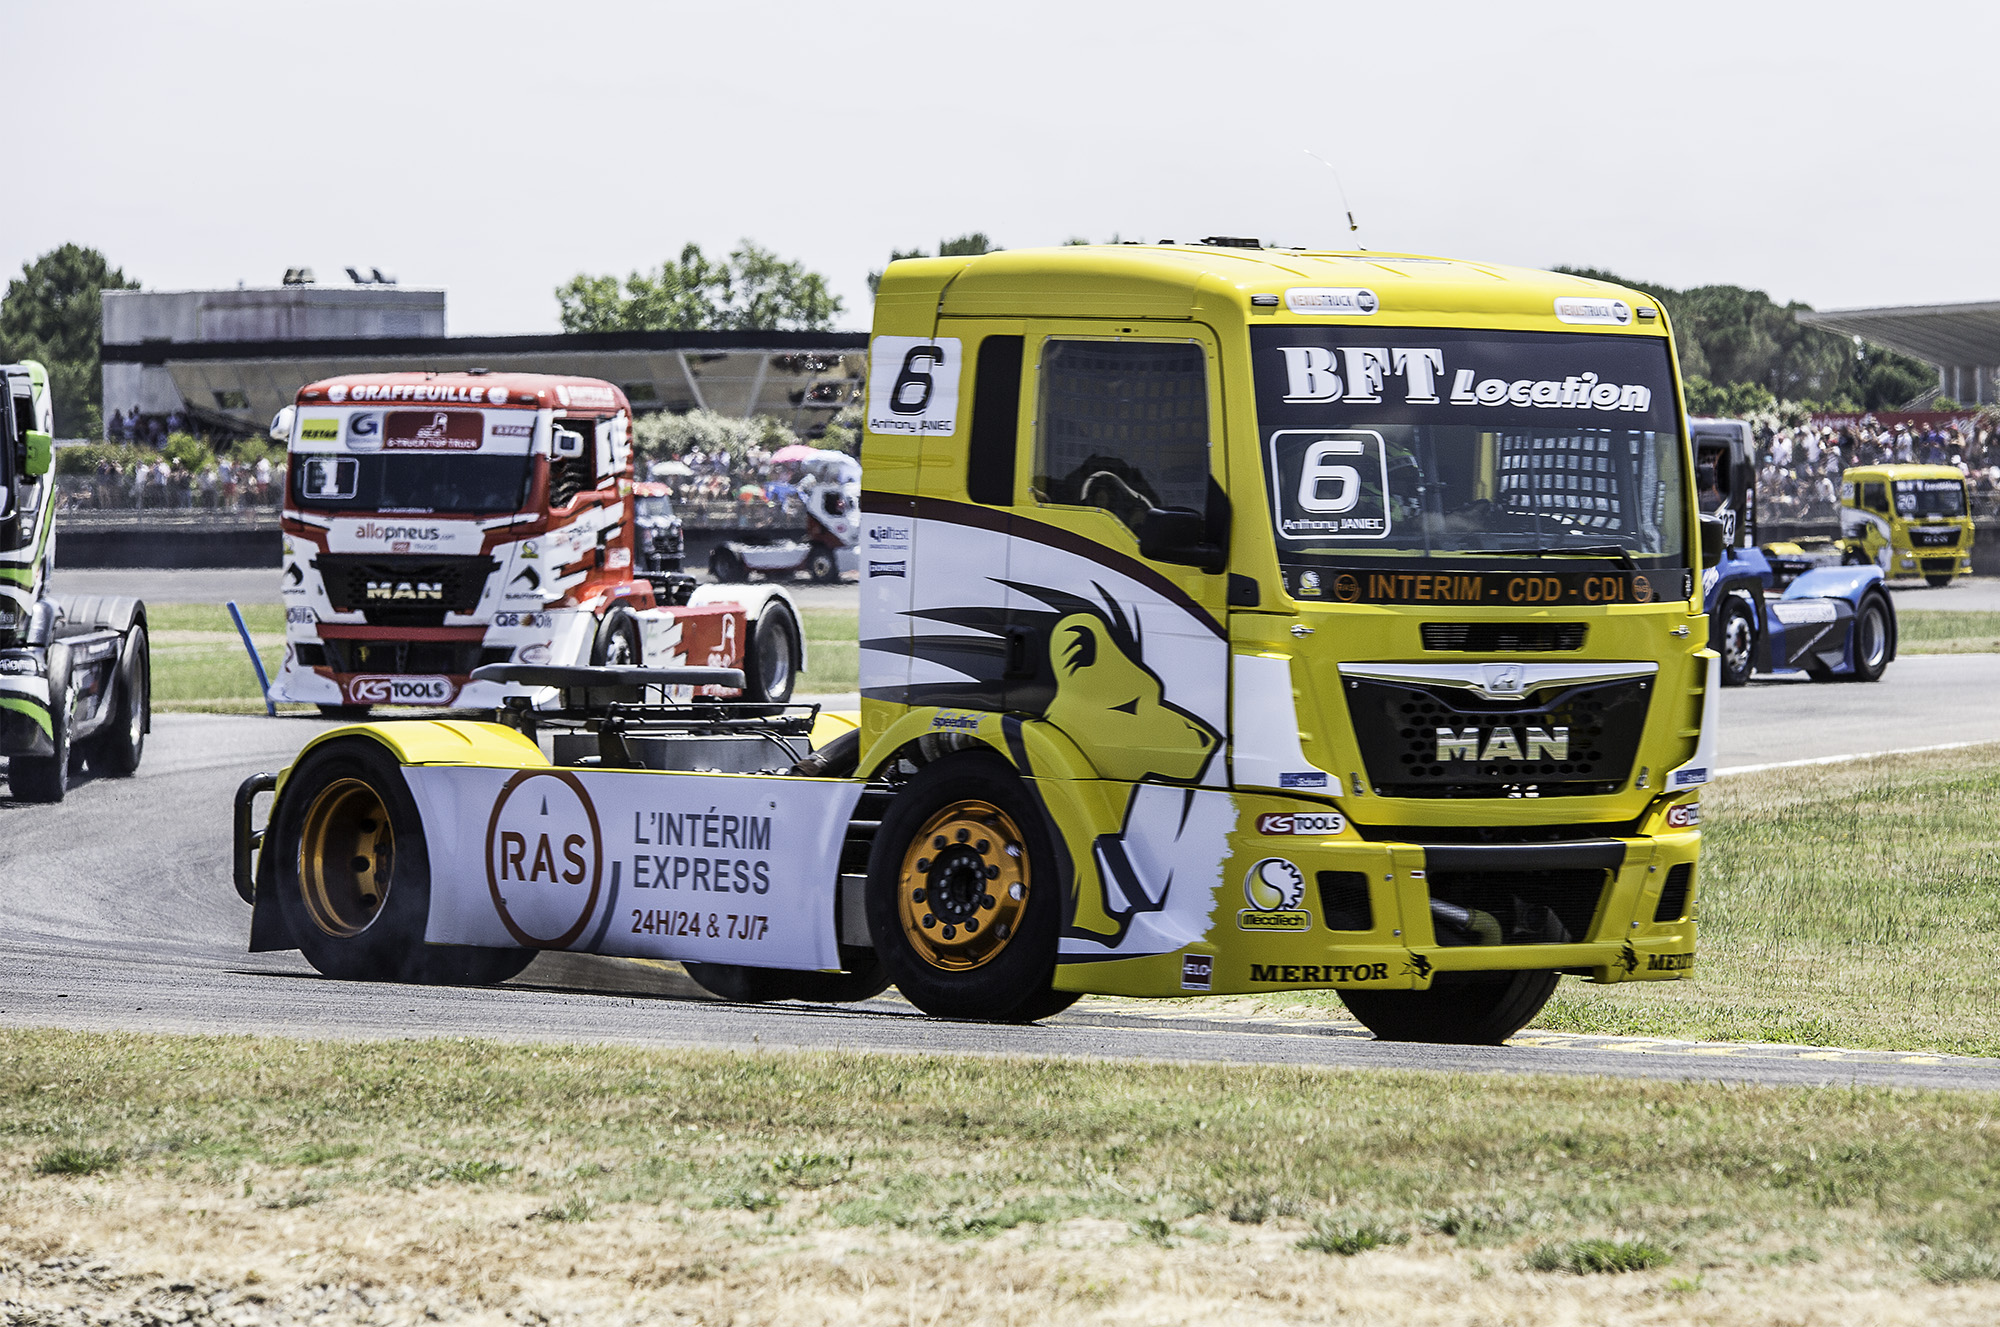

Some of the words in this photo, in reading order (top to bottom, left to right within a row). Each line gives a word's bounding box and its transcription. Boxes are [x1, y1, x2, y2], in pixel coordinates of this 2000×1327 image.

[351, 384, 484, 402] GRAFFEUILLE
[889, 345, 944, 416] 6
[1277, 347, 1445, 404] BFT
[1450, 369, 1651, 412] Location
[321, 459, 339, 495] 1
[1298, 440, 1364, 513] 6
[1282, 518, 1339, 532] Anthony
[366, 581, 443, 599] MAN
[1369, 575, 1483, 601] INTERIM
[1507, 577, 1561, 602] CDD
[1584, 576, 1624, 600] CDI
[496, 614, 519, 627] Q8
[392, 683, 444, 697] TOOLS
[1436, 726, 1570, 761] MAN
[634, 806, 772, 850] L'INTÉRIM
[1294, 816, 1341, 831] TOOLS
[501, 831, 587, 885] RAS
[633, 854, 770, 895] EXPRESS
[631, 909, 701, 936] 24H/24
[706, 913, 720, 938] &
[727, 914, 769, 940] 7J/7
[1250, 963, 1389, 983] MERITOR
